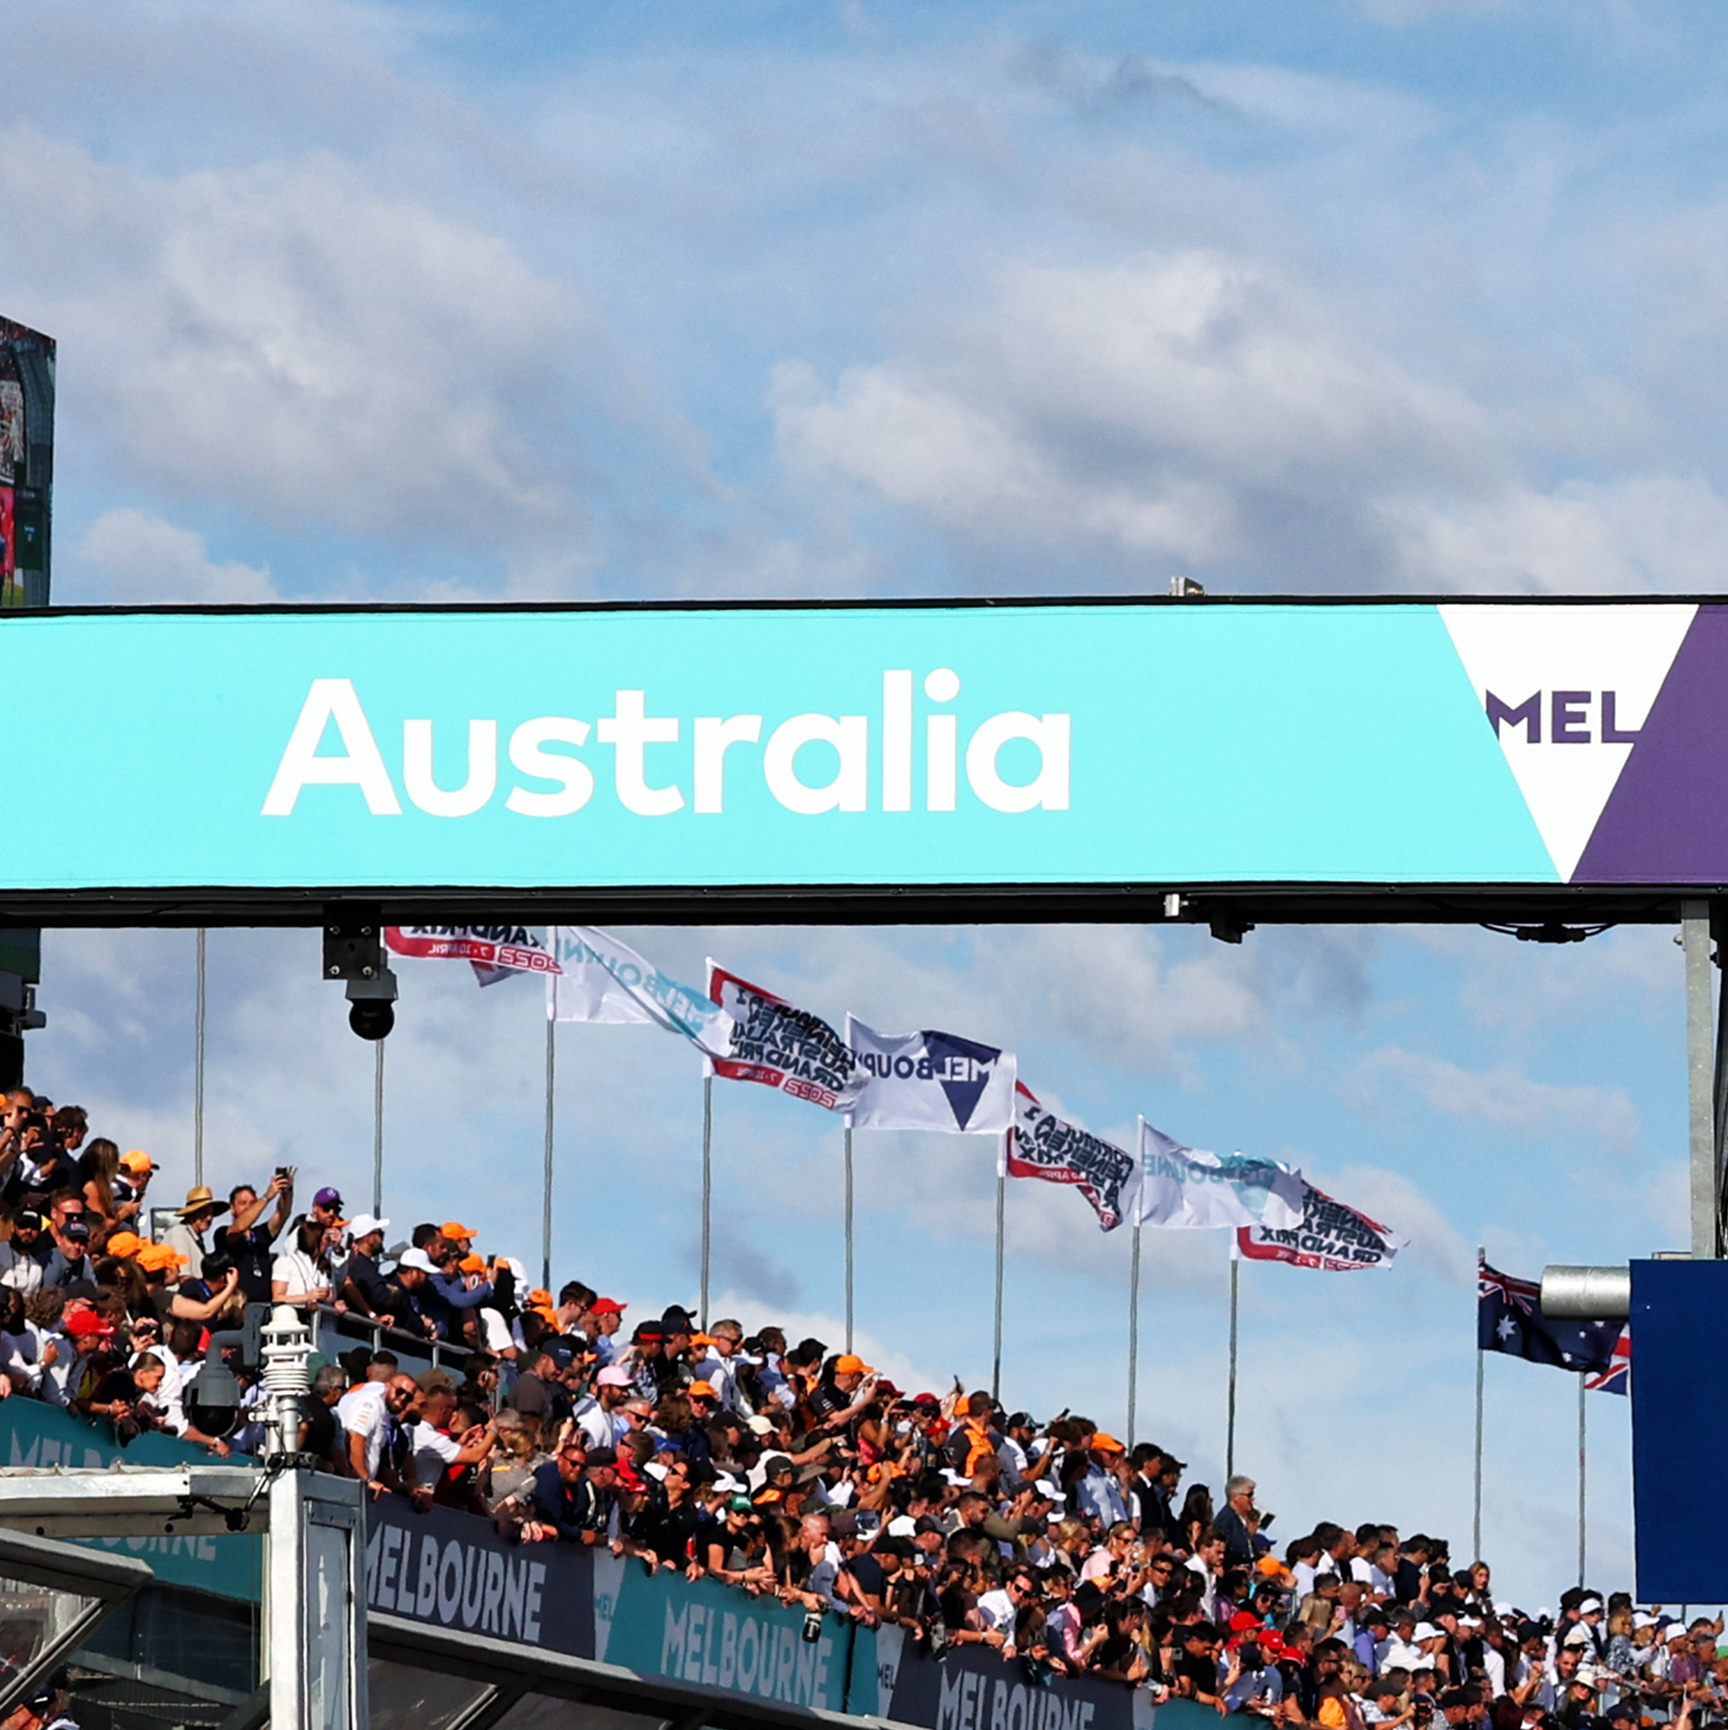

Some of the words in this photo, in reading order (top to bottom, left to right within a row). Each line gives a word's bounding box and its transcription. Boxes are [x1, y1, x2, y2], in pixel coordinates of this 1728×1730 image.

[260, 667, 1072, 817] Australia
[1486, 689, 1640, 744] MEL
[661, 1597, 834, 1709] MELBOURNE
